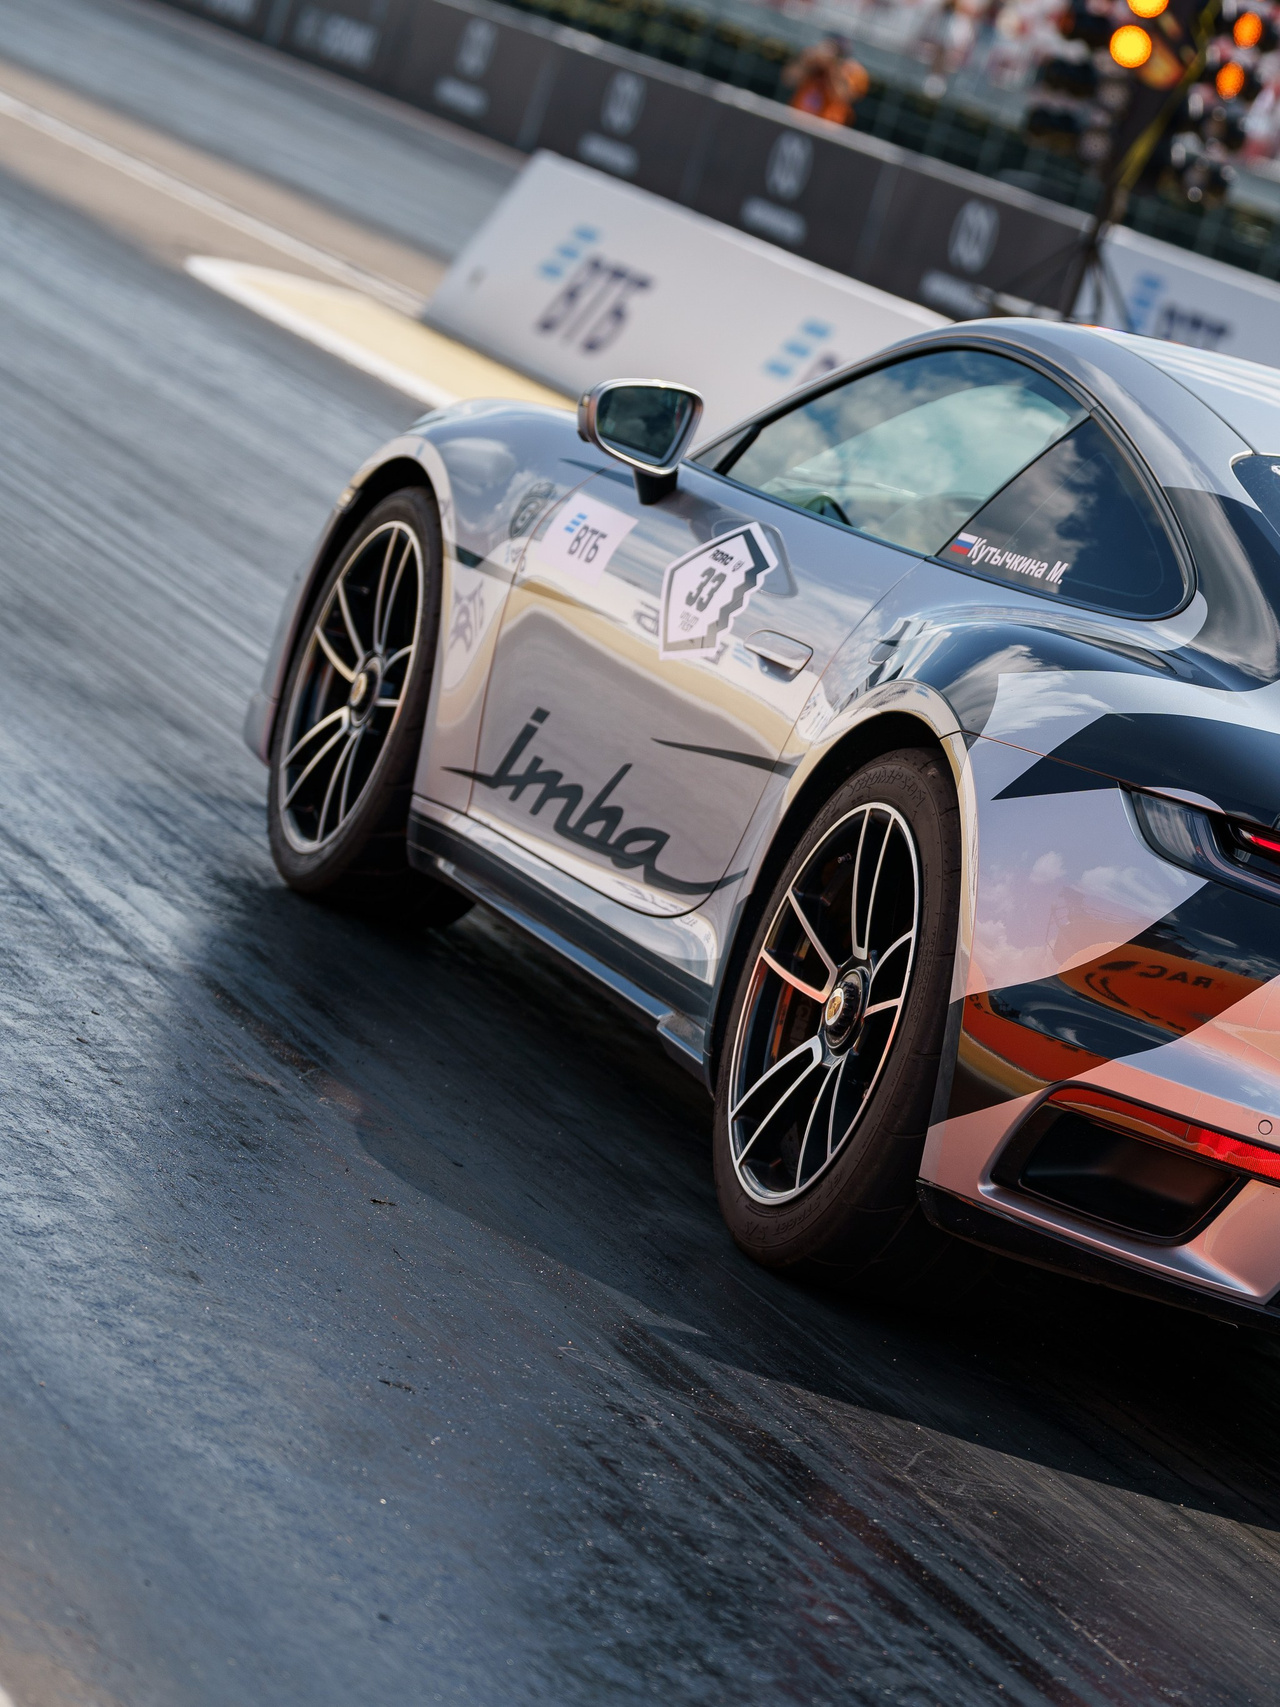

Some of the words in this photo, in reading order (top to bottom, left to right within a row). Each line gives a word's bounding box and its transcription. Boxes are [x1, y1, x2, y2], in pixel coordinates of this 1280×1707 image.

[536, 256, 653, 354] ВТБ
[566, 524, 608, 566] ВТБ
[967, 537, 1049, 579] Кутычкина
[1045, 560, 1069, 585] М.
[685, 567, 727, 612] 33
